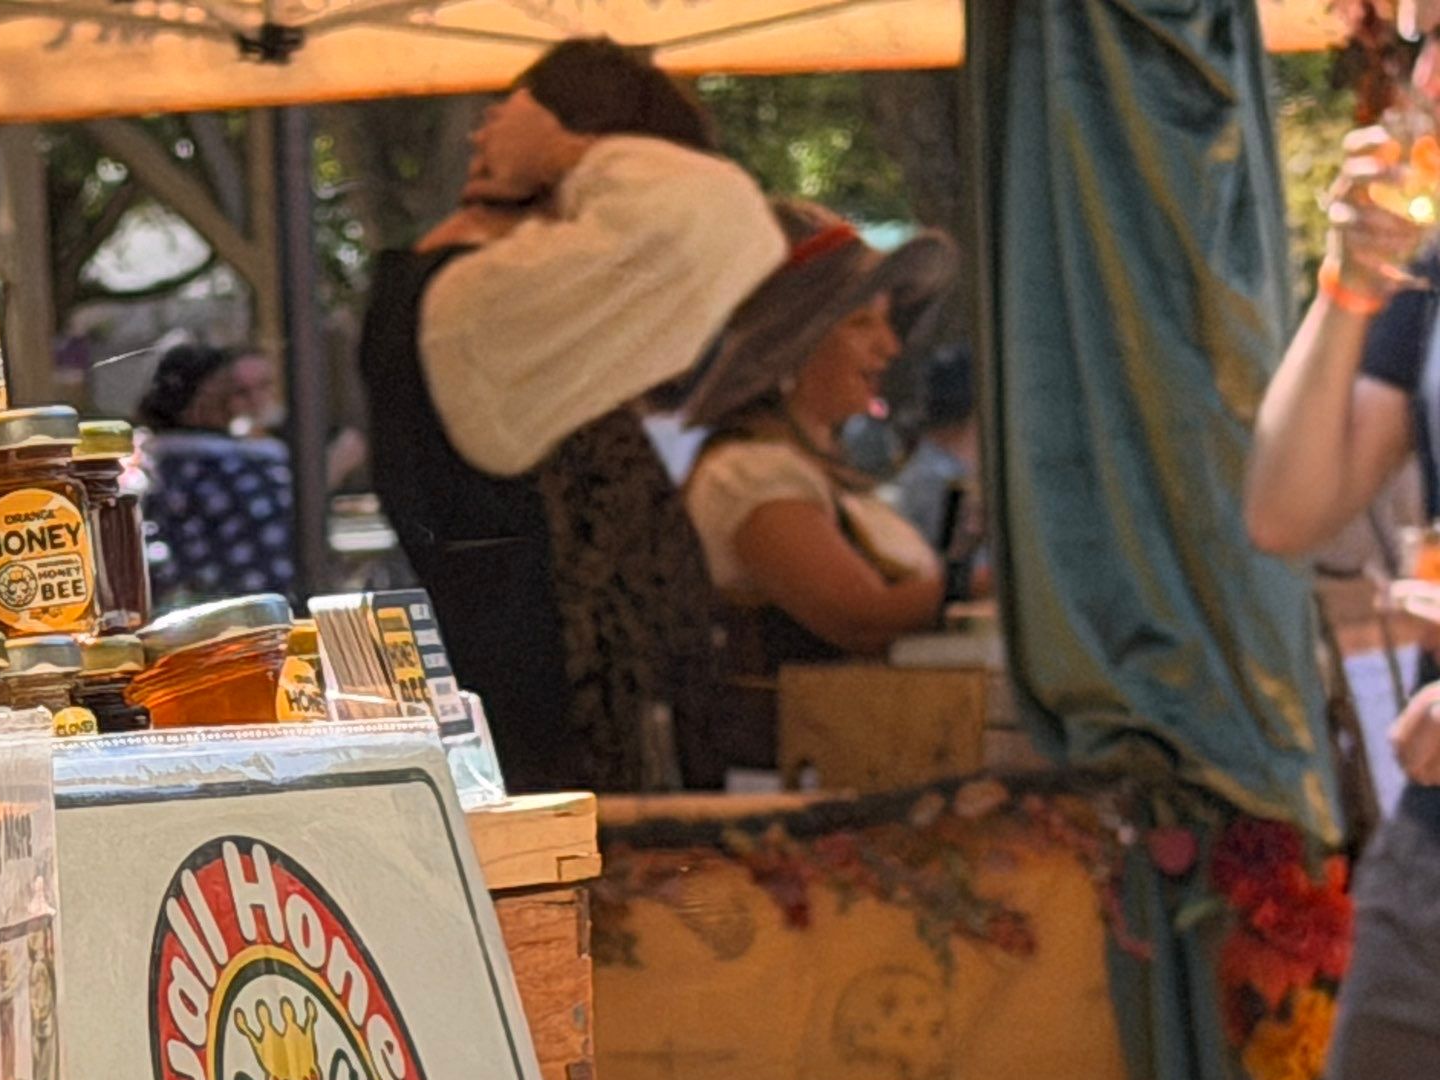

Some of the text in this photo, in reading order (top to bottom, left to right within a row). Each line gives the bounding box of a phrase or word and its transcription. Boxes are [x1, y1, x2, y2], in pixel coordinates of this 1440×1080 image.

[3, 509, 56, 526] ORANGE
[36, 565, 82, 581] HONEY
[40, 578, 86, 602] BEE
